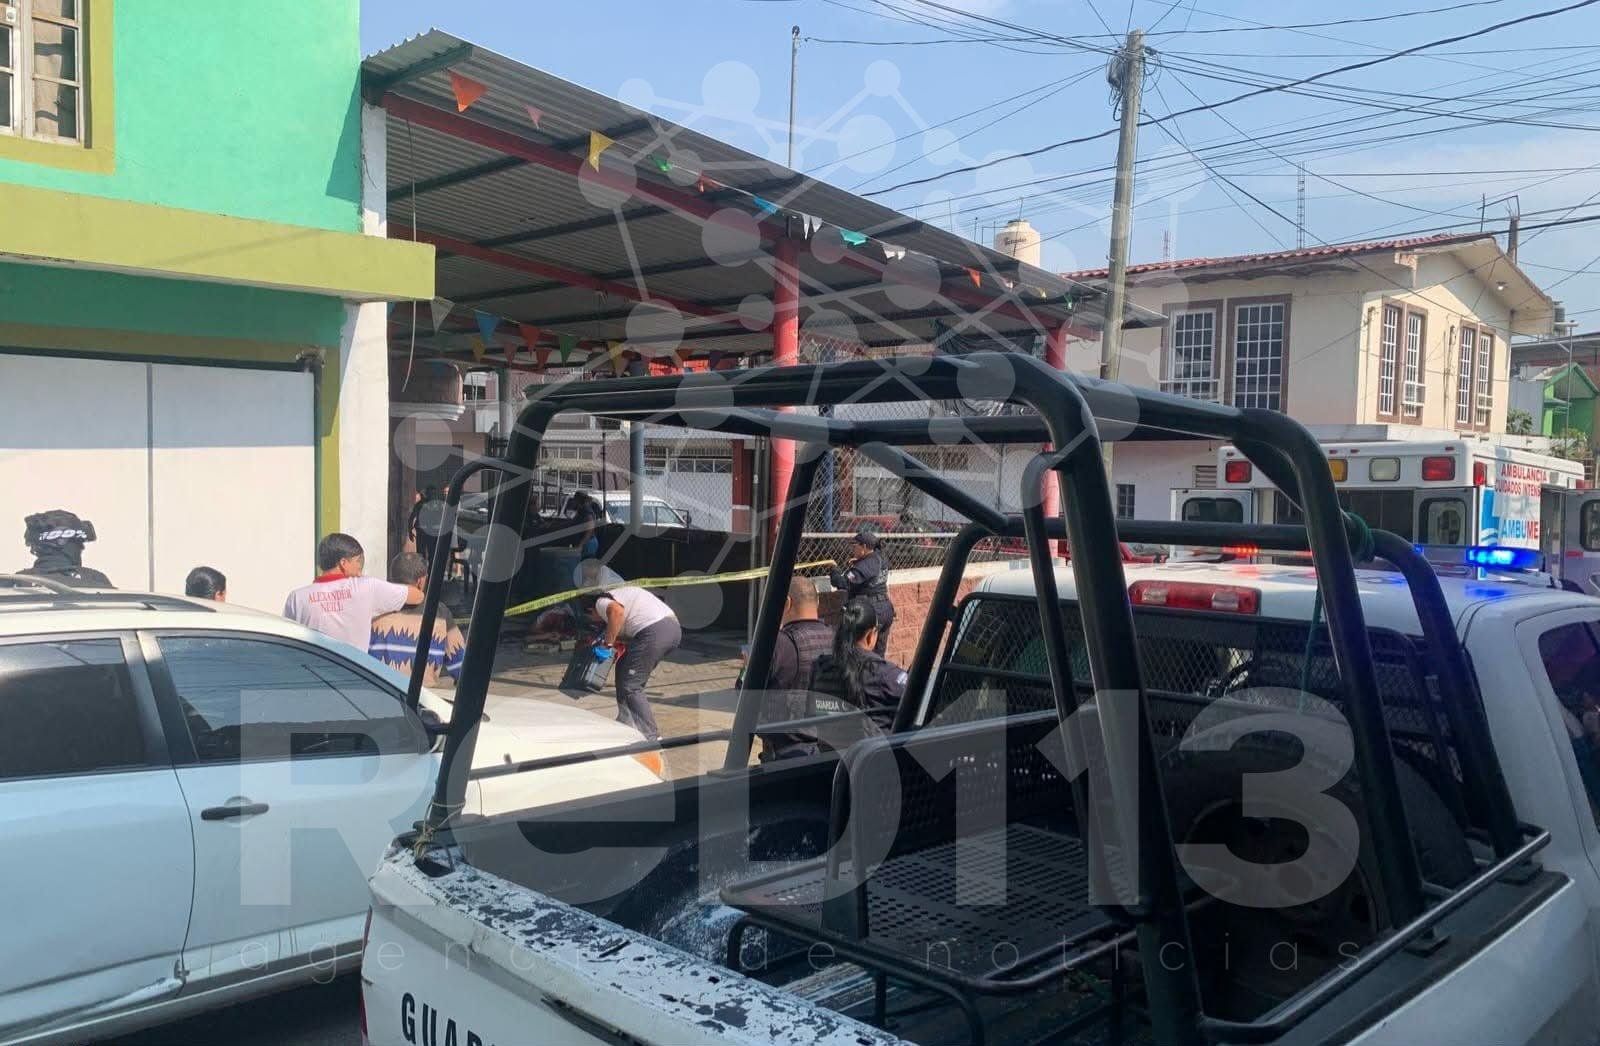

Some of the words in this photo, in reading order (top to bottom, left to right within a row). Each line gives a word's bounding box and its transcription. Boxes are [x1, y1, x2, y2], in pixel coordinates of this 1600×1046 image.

[1501, 463, 1547, 482] AMBULANCIA
[39, 529, 87, 541] 100%
[308, 588, 352, 603] ALEXANDER
[815, 700, 840, 711] GUARDIA
